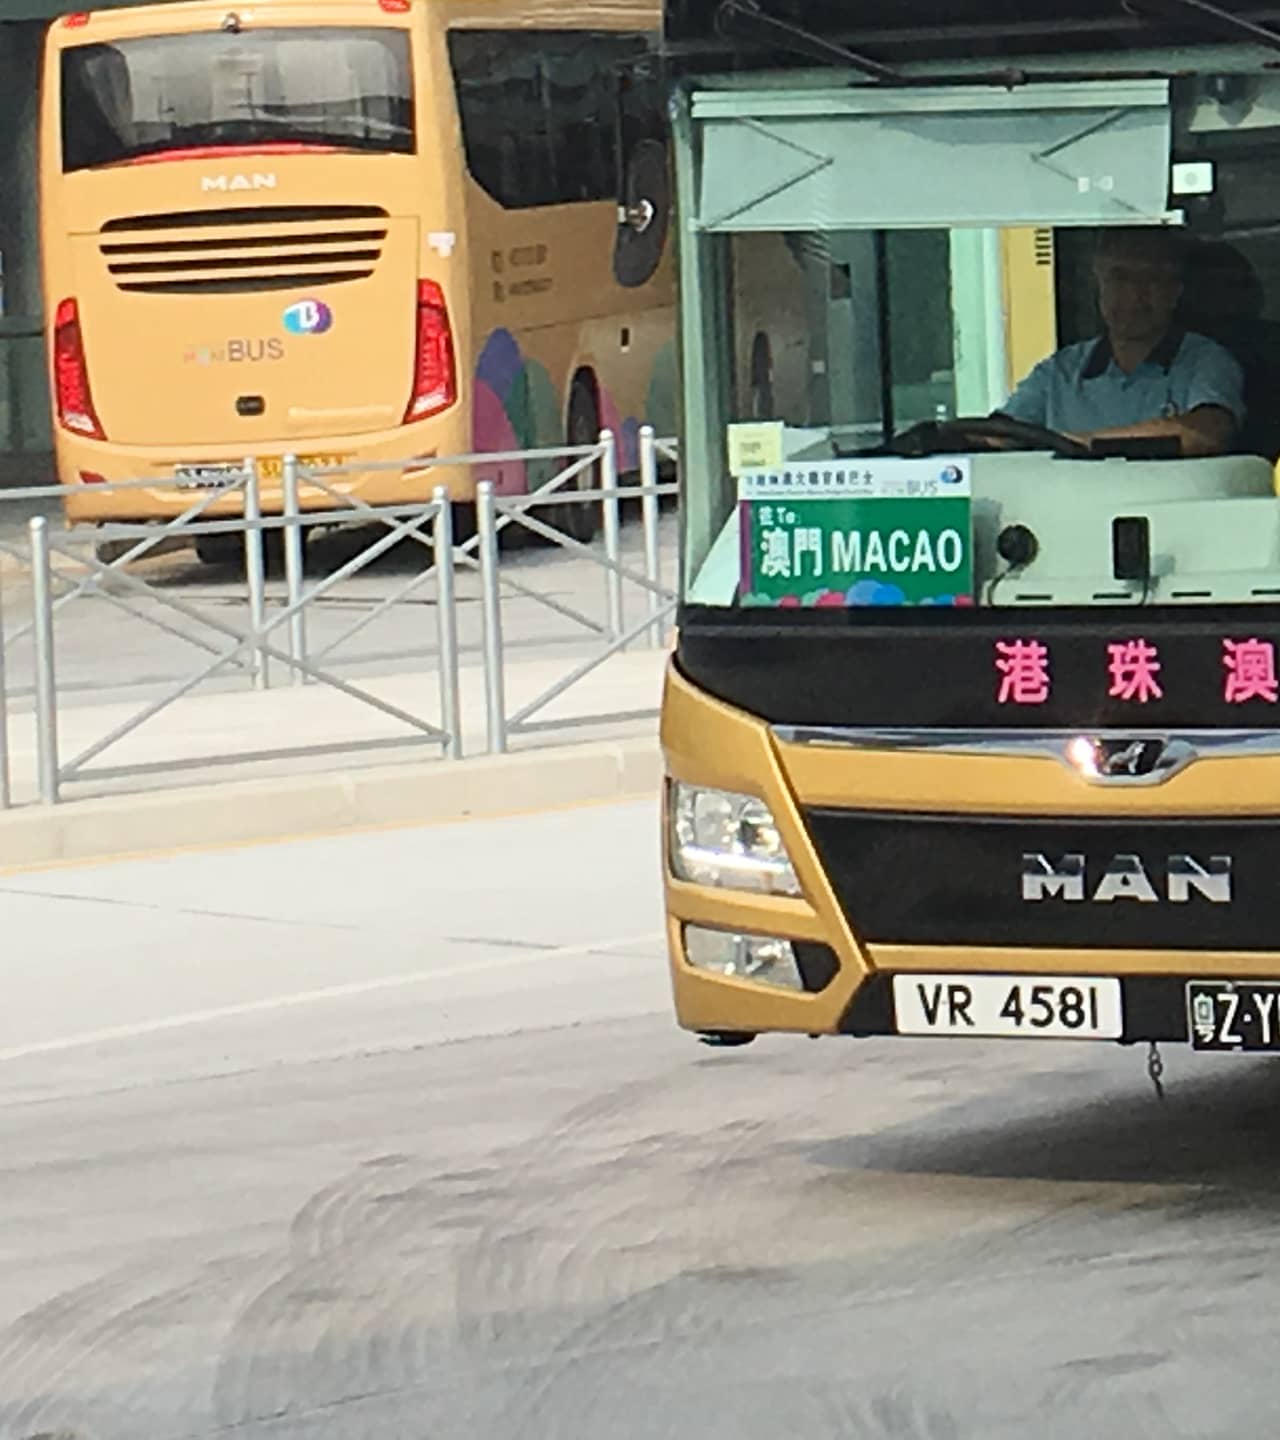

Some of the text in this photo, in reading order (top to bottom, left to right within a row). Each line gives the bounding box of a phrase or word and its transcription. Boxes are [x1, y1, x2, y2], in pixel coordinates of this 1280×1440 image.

[200, 172, 277, 191] MAN
[760, 527, 963, 578] 澳門 MACAO
[1022, 854, 1232, 902] MAN
[918, 983, 1098, 1030] VR 4581
